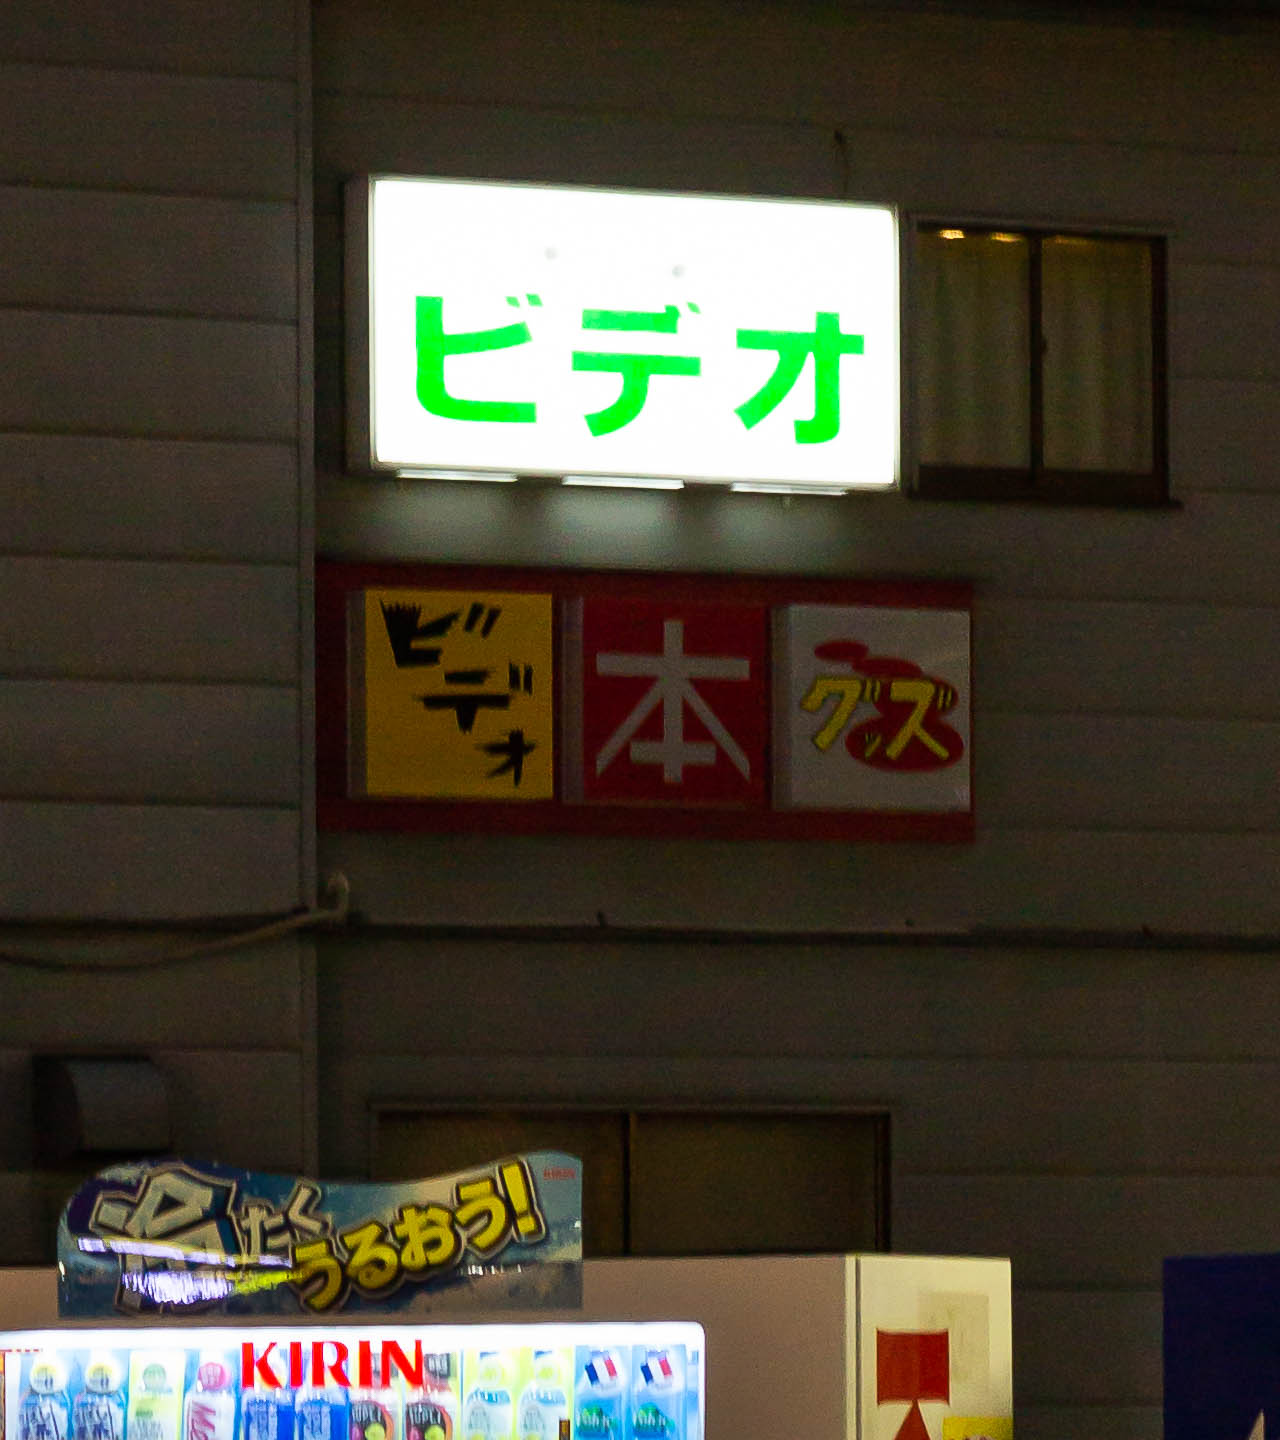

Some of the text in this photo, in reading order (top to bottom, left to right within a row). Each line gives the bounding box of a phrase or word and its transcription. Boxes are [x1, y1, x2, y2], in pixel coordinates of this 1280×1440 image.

[415, 293, 865, 444] ビデオ
[379, 598, 536, 787] ビデオ
[595, 620, 751, 785] 本
[800, 674, 953, 762] グッズ
[240, 1339, 423, 1388] KIRIN
